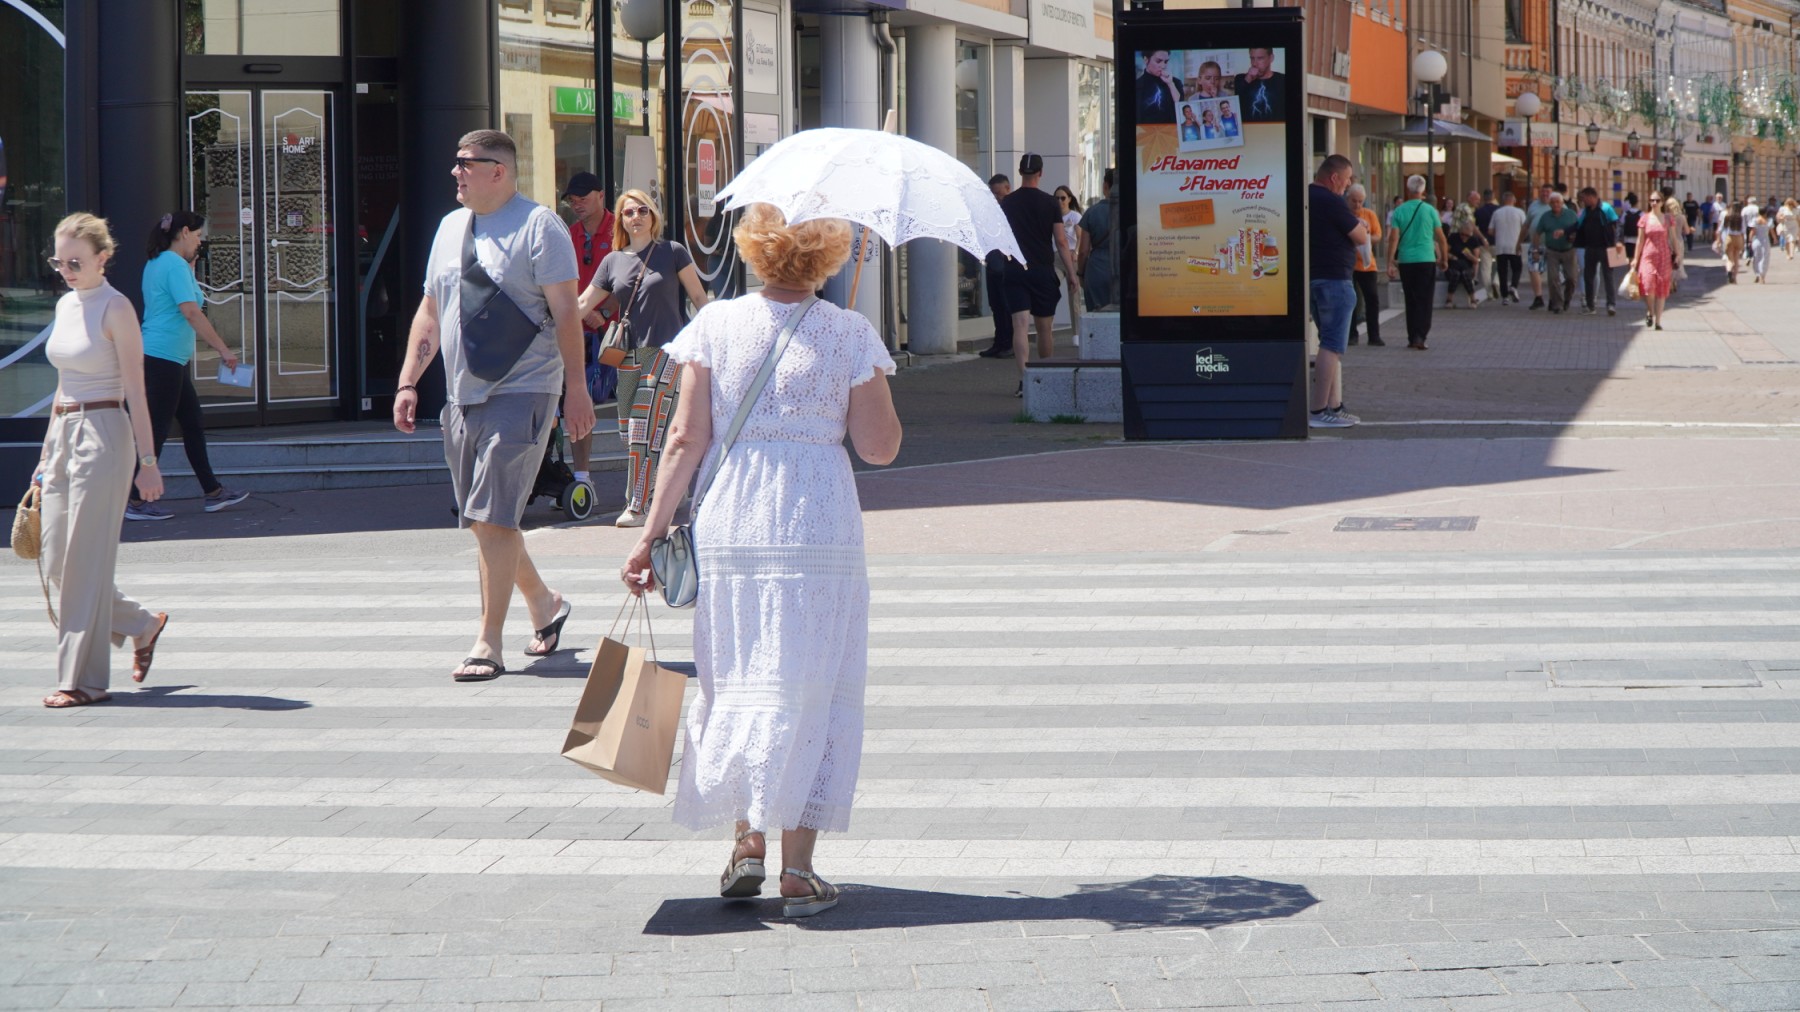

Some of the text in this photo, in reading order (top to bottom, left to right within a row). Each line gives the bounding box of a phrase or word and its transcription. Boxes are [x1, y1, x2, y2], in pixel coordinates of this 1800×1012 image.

[283, 136, 316, 145] SART
[283, 145, 306, 153] HOME
[1161, 155, 1240, 171] Flavamed
[1190, 174, 1270, 191] Flavamed
[1241, 190, 1265, 200] forte
[1196, 354, 1212, 364] led
[1196, 362, 1229, 372] media
